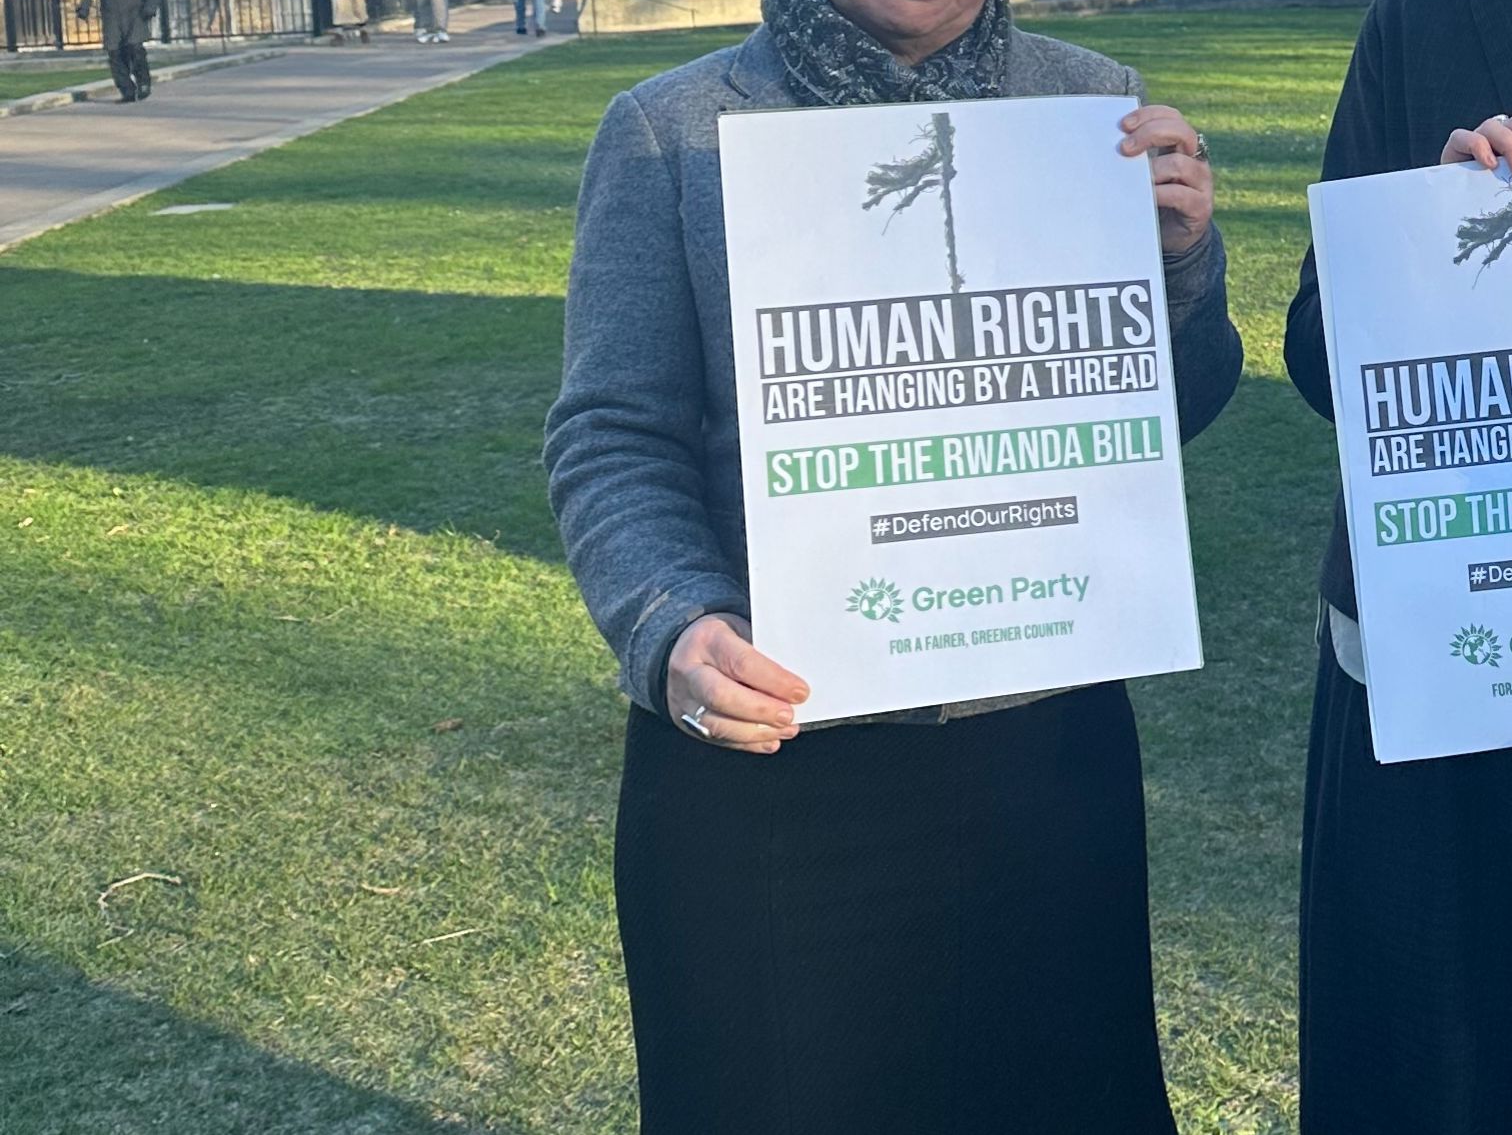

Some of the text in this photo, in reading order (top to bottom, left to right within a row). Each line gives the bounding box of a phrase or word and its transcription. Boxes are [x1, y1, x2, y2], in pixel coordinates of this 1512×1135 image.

[760, 285, 1152, 375] HUMAN RIGHTS
[766, 354, 1156, 421] ARE HANGING BY A THREAD
[772, 418, 1160, 494] STOP THE RWANDA BILL
[1373, 434, 1424, 472] ARE
[872, 500, 1076, 538] #DefendOurRights
[1380, 498, 1456, 542] STOP
[912, 574, 1090, 612] Green Party
[890, 621, 1074, 655] FOR A FAIRER, GREENER COUNTRY
[1492, 682, 1512, 697] FOR
